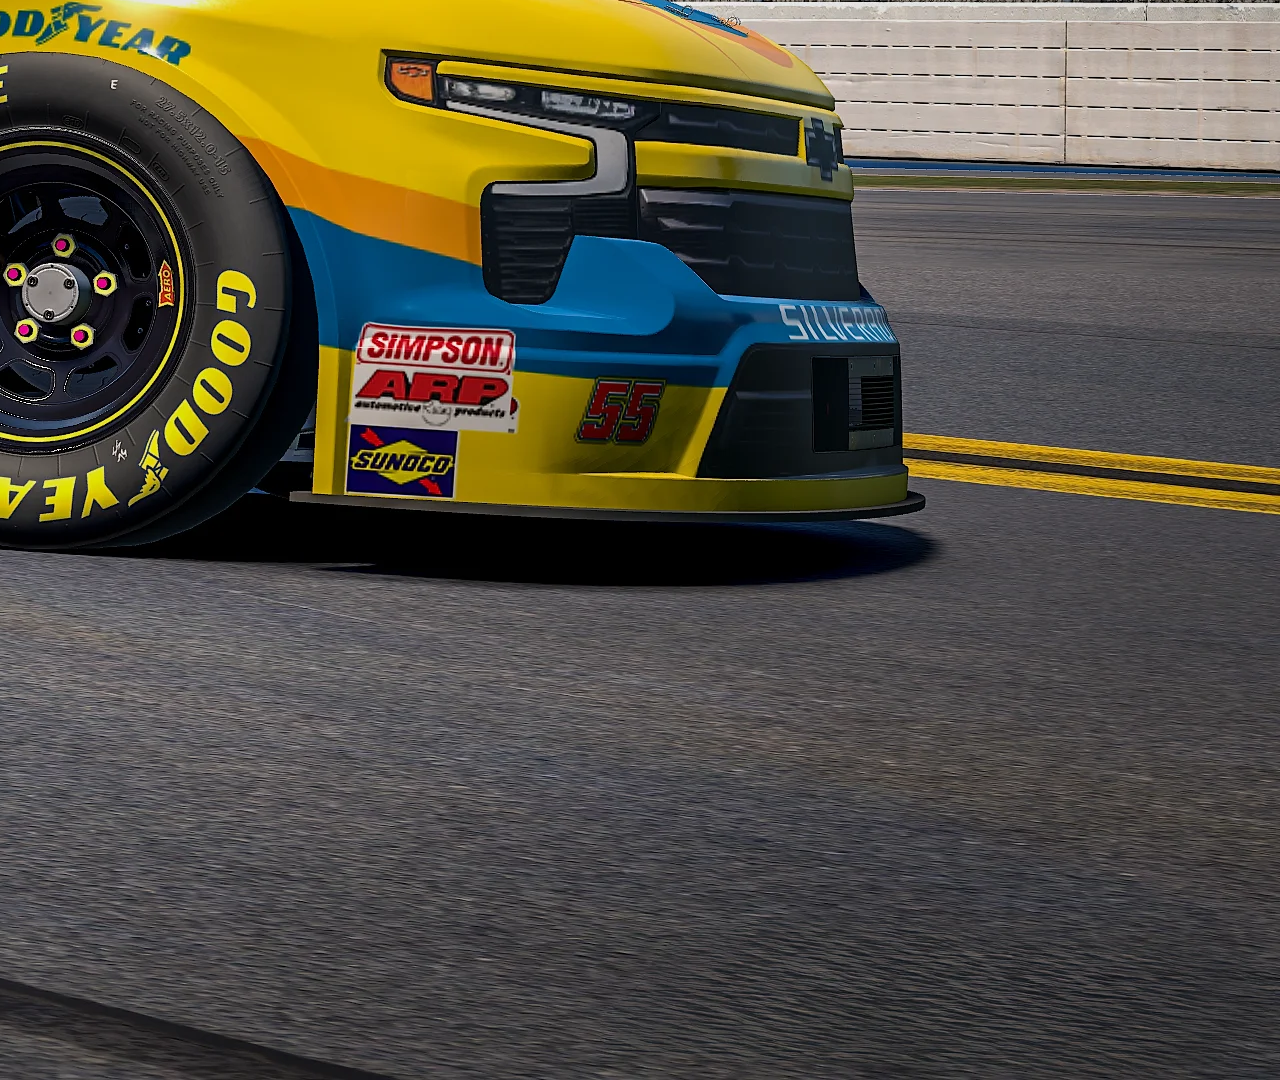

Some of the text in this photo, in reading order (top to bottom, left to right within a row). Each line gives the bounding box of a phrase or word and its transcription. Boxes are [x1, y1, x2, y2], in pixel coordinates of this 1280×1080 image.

[779, 303, 899, 342] SILVERAD
[367, 331, 504, 367] SIMPSON
[355, 369, 509, 406] ARP
[576, 378, 665, 444] 55
[354, 451, 452, 474] SUNOCO
